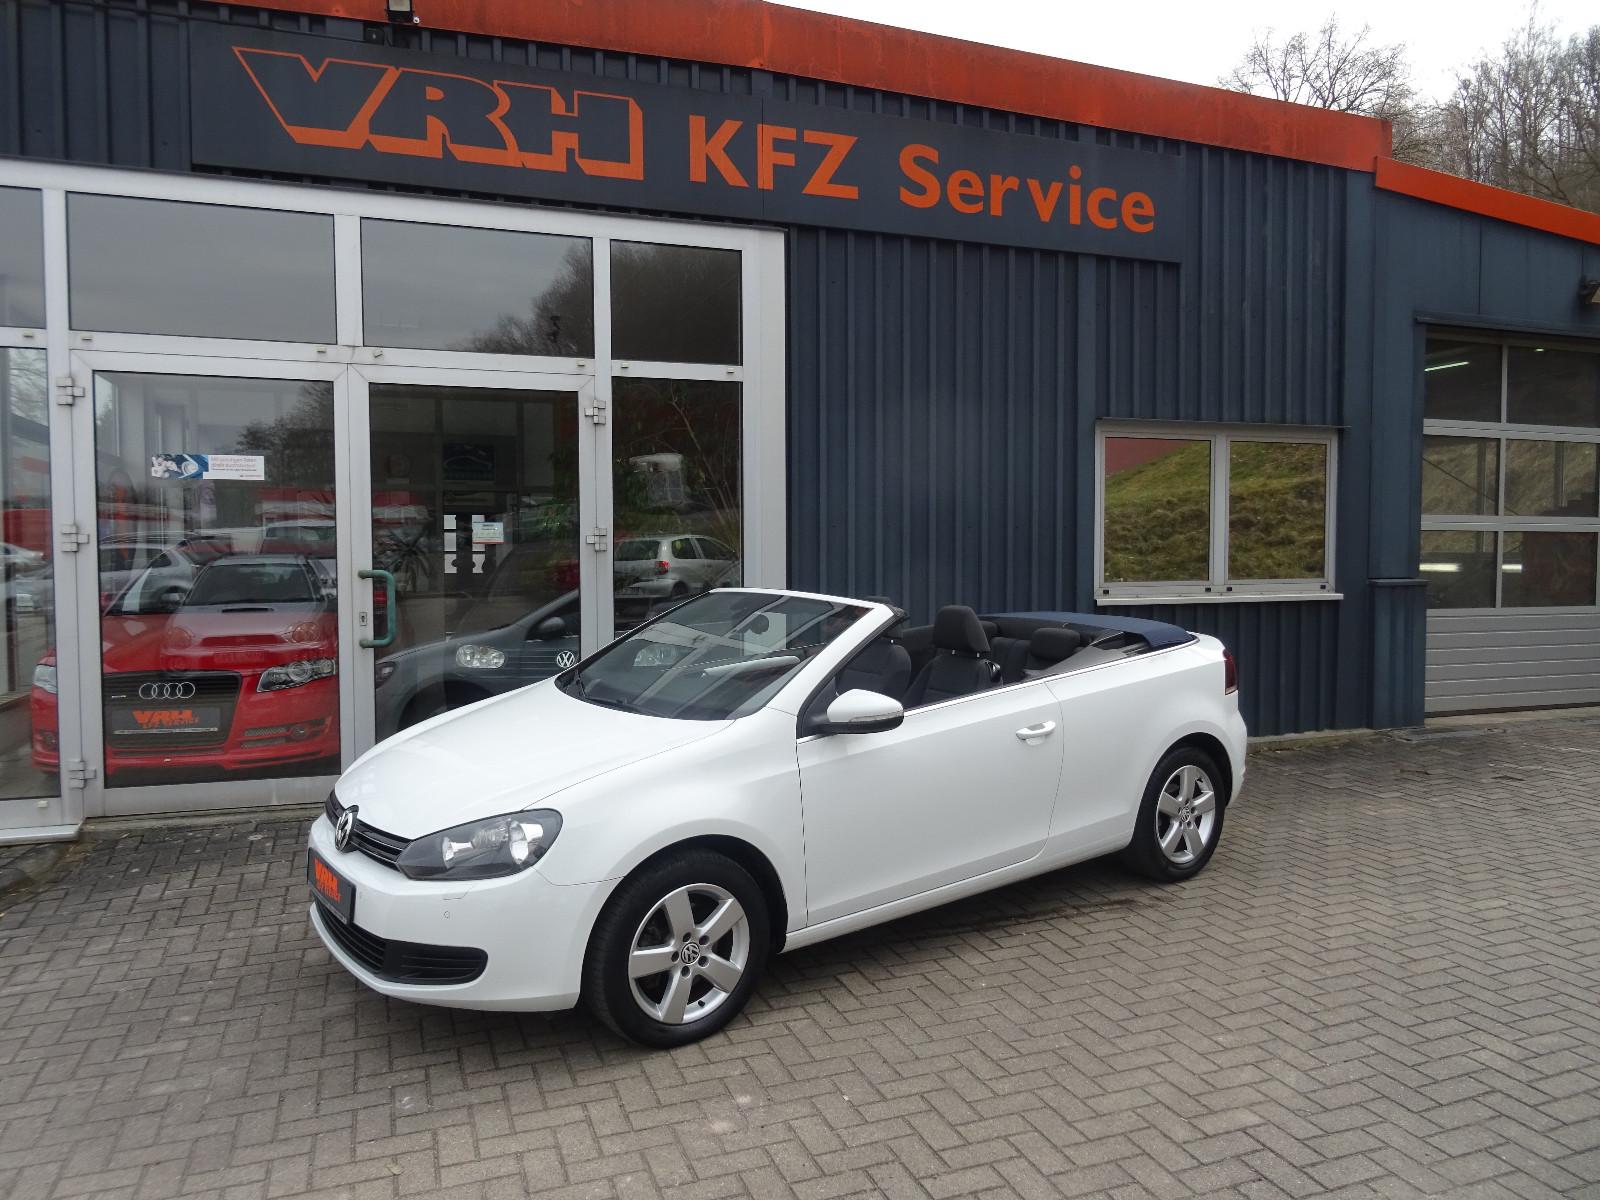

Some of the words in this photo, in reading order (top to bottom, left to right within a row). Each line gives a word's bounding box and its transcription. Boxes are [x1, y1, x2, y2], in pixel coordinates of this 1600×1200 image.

[232, 46, 644, 180] VRH
[689, 115, 859, 199] KFZ
[899, 143, 1155, 233] Service
[132, 709, 193, 725] VRH
